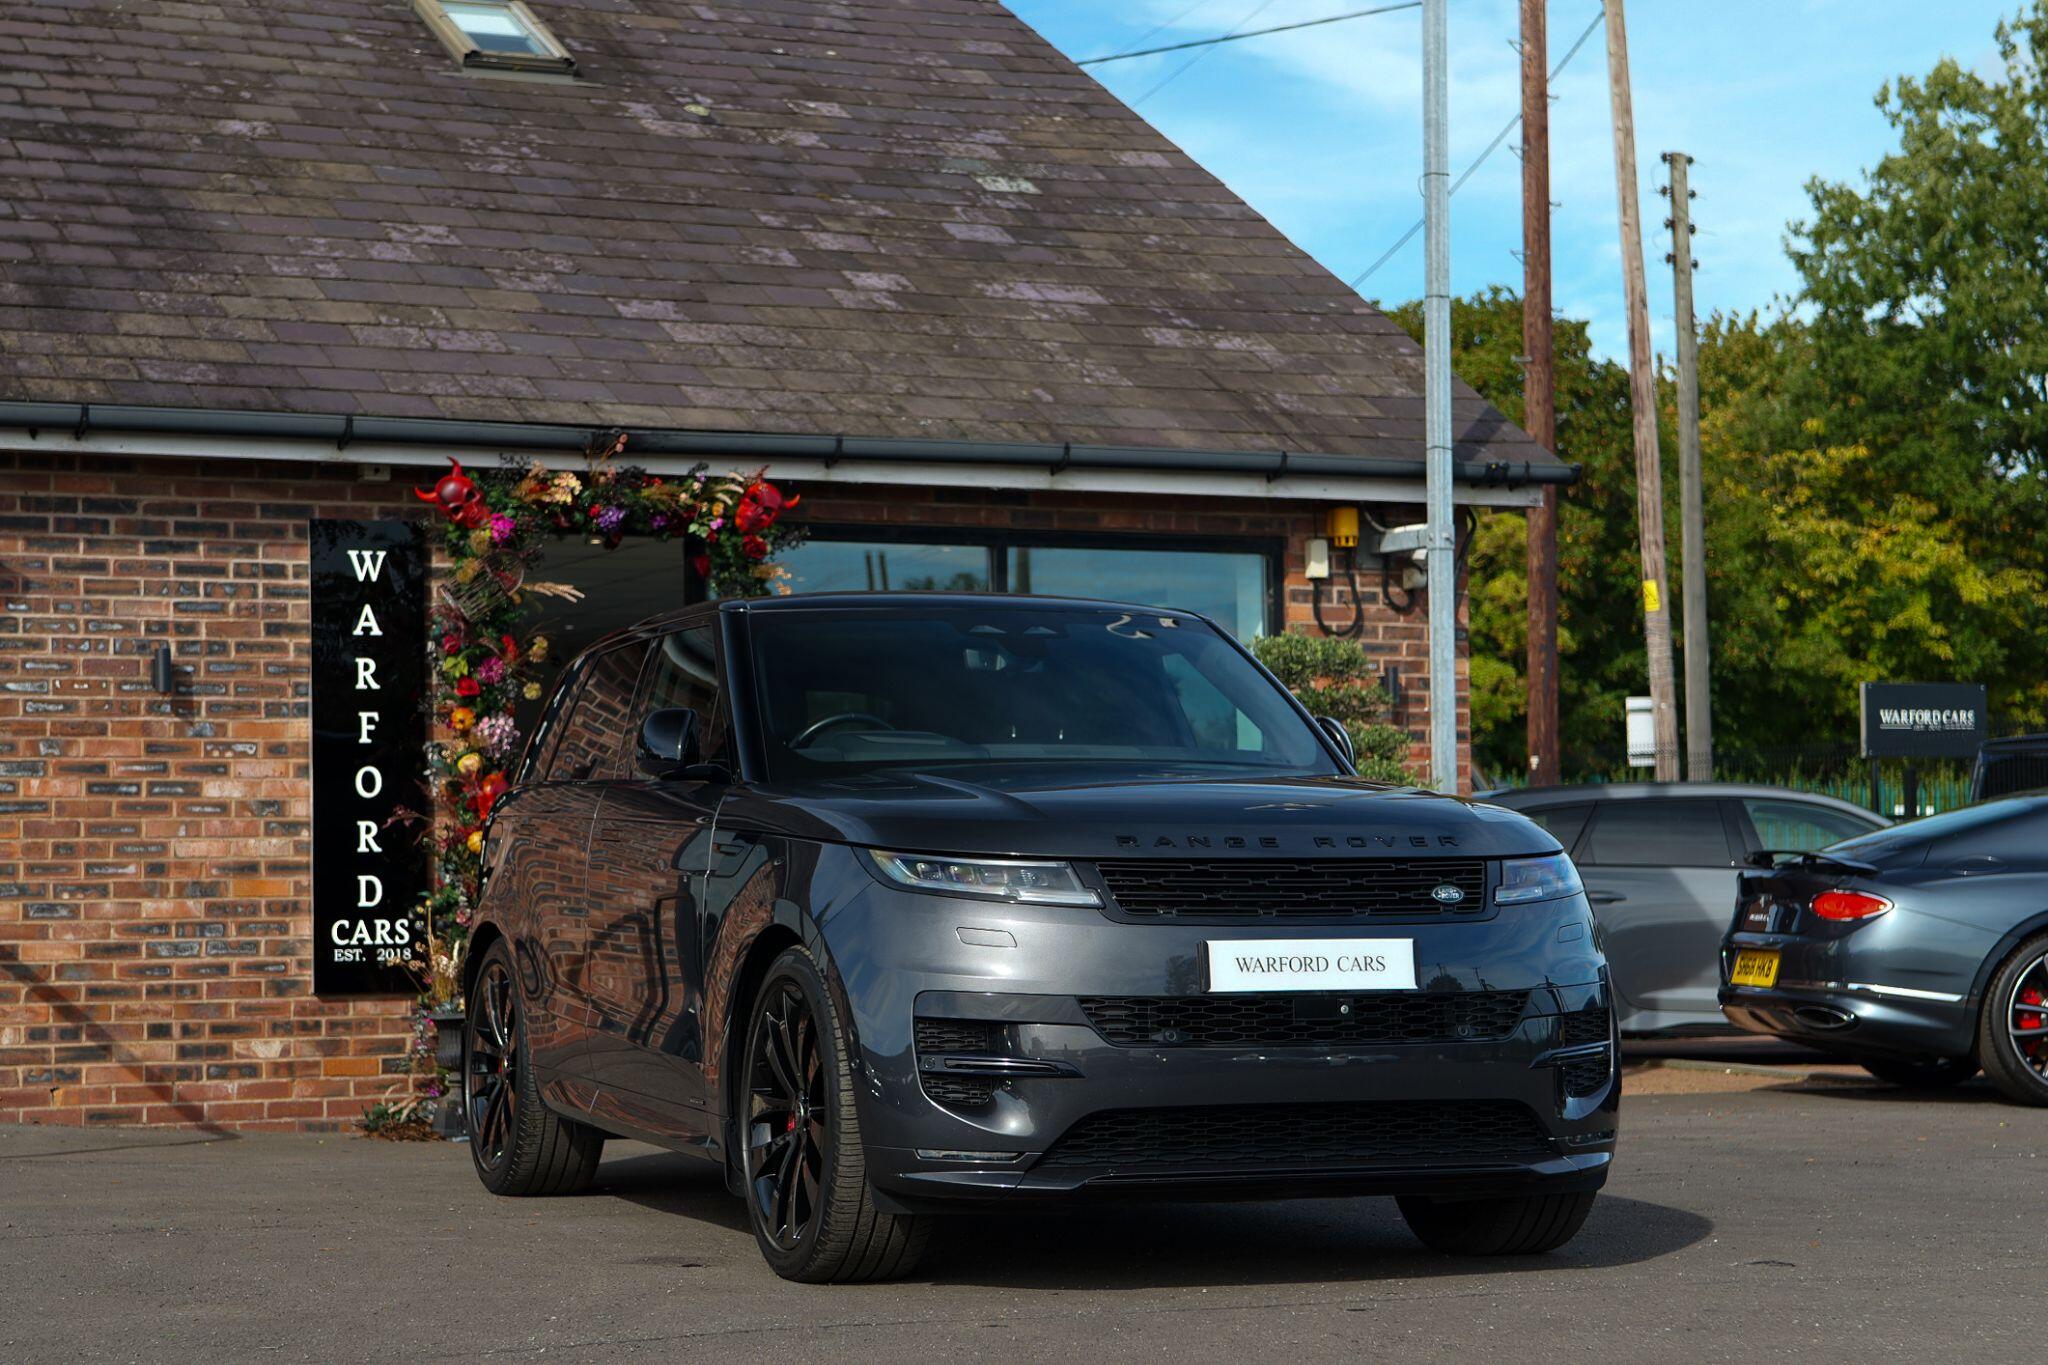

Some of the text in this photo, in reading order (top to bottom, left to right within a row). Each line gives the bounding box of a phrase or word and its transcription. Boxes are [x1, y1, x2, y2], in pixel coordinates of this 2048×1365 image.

[1879, 708, 1975, 725] WARFORD CARS
[346, 549, 387, 908] WARFORD
[1115, 835, 1461, 849] RANGE ROVER
[331, 919, 410, 946] CARS
[333, 947, 412, 962] EST. 2018
[1236, 956, 1386, 973] WARFORD CARS
